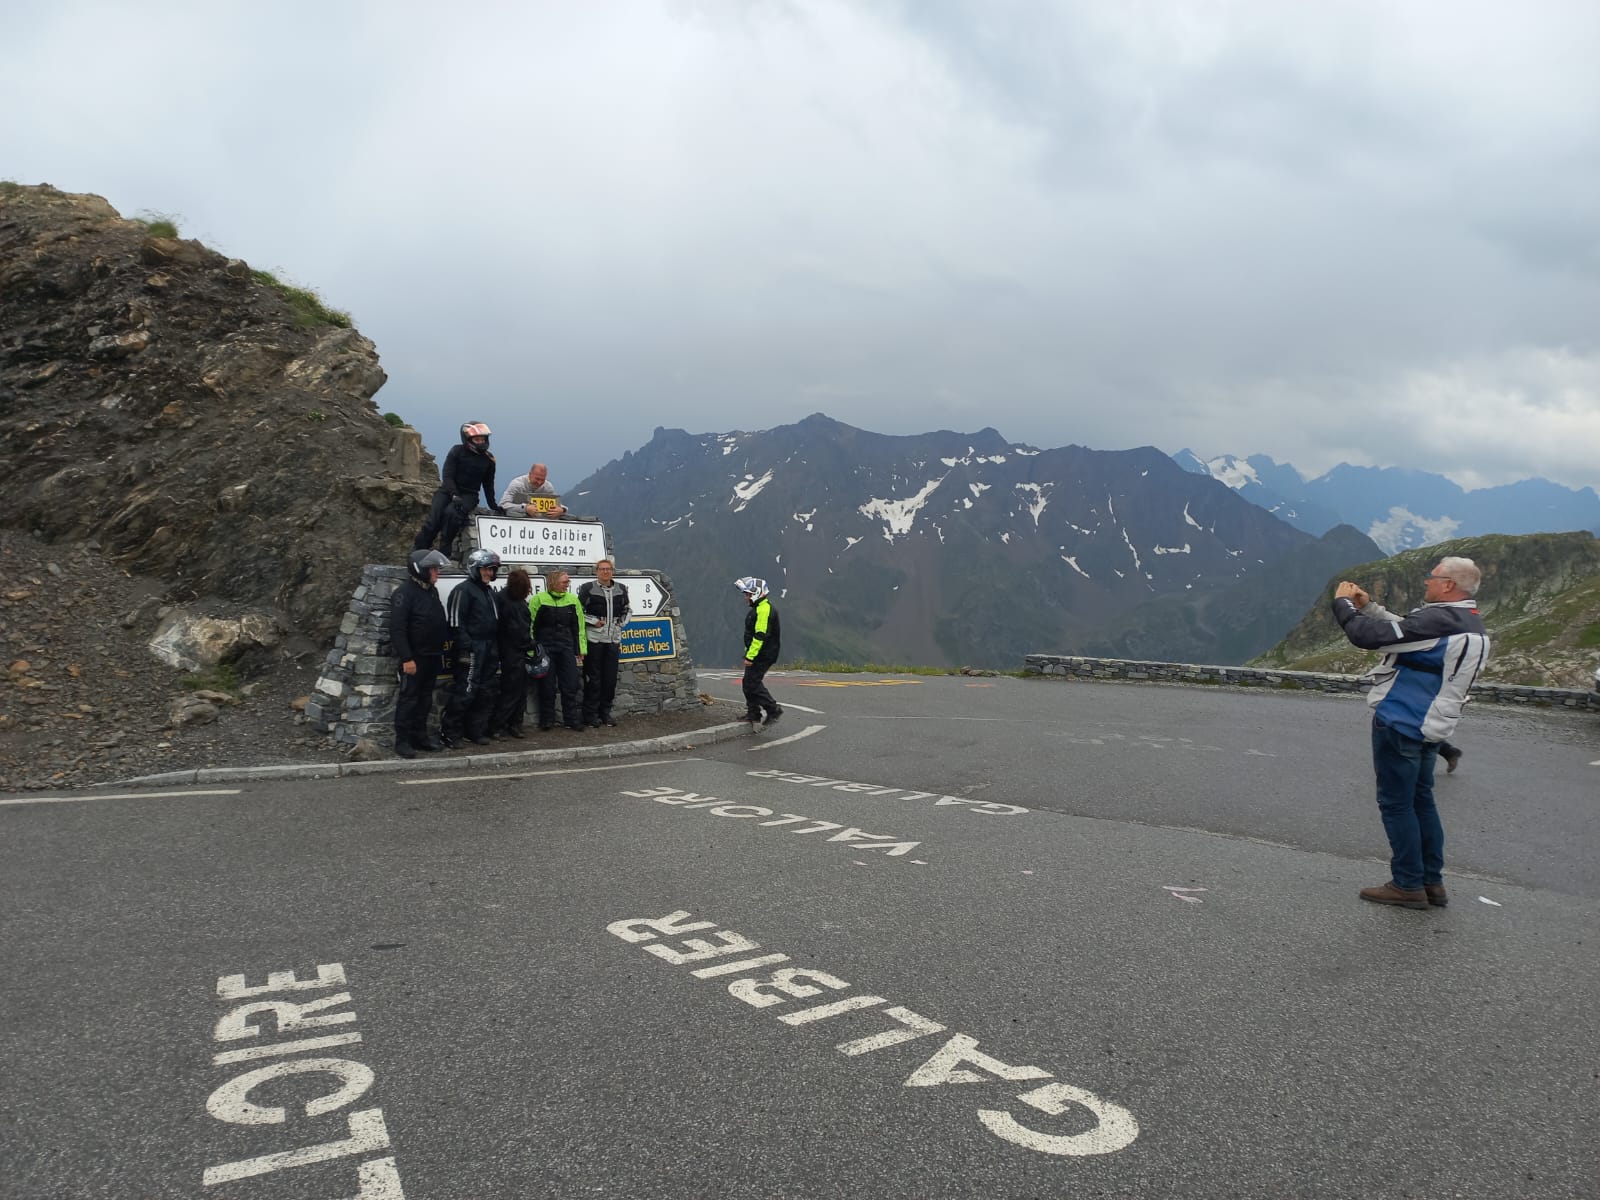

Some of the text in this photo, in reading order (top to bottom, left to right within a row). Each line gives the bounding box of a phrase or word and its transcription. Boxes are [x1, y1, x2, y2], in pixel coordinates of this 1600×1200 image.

[489, 524, 593, 542] Col du Galibier
[502, 543, 586, 557] altitude 2642 m
[645, 583, 651, 593] 8
[641, 599, 653, 609] 35
[621, 627, 662, 639] artement
[648, 640, 670, 654] Alpes
[745, 768, 1030, 816] GALIBIER
[619, 786, 922, 857] VALLOIRE
[606, 909, 1140, 1157] GALIBIER
[203, 963, 406, 1200] LOIRE
